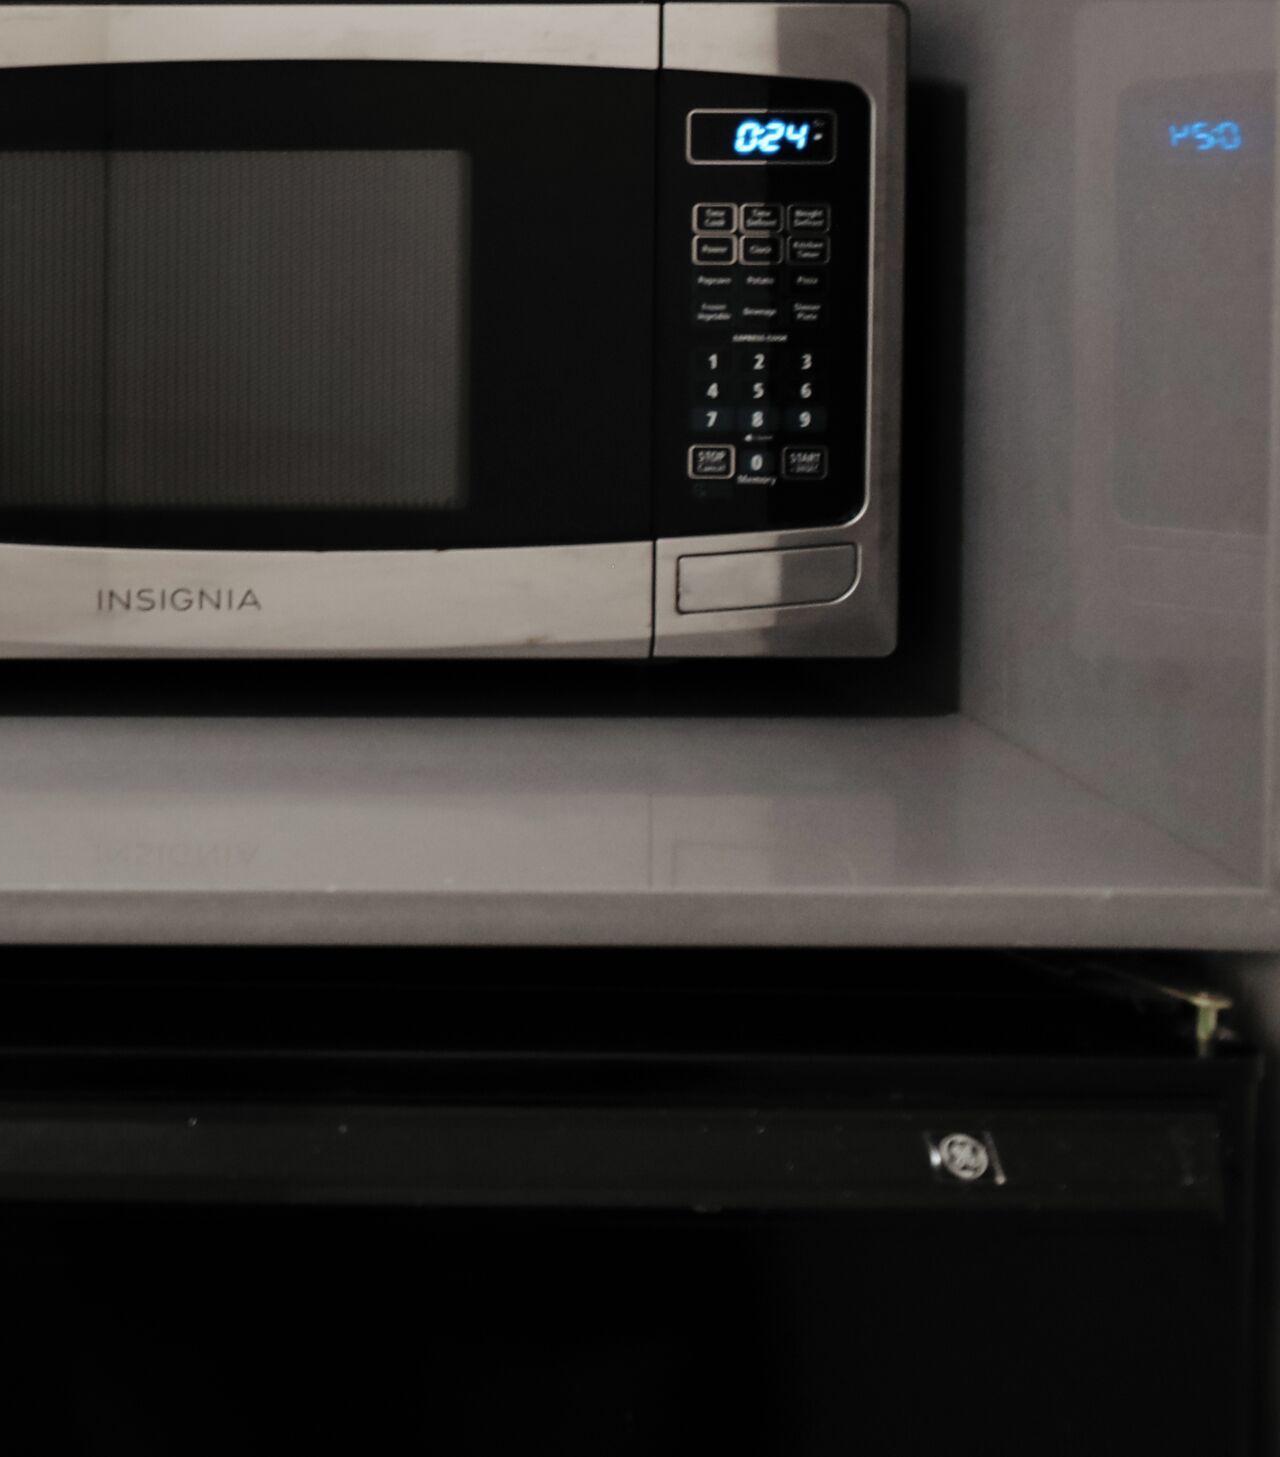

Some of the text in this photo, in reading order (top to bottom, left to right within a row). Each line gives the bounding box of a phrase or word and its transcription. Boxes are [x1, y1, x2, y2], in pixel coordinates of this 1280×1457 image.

[708, 353, 718, 370] 1
[753, 353, 766, 370] 2
[801, 353, 813, 370] 3
[706, 382, 720, 399] 4
[752, 382, 765, 399] 5
[800, 382, 812, 399] 6
[705, 411, 718, 428] 7
[751, 411, 764, 428] 8
[799, 411, 812, 428] 9
[750, 453, 764, 472] 0
[96, 587, 262, 612] INSIGNIA
